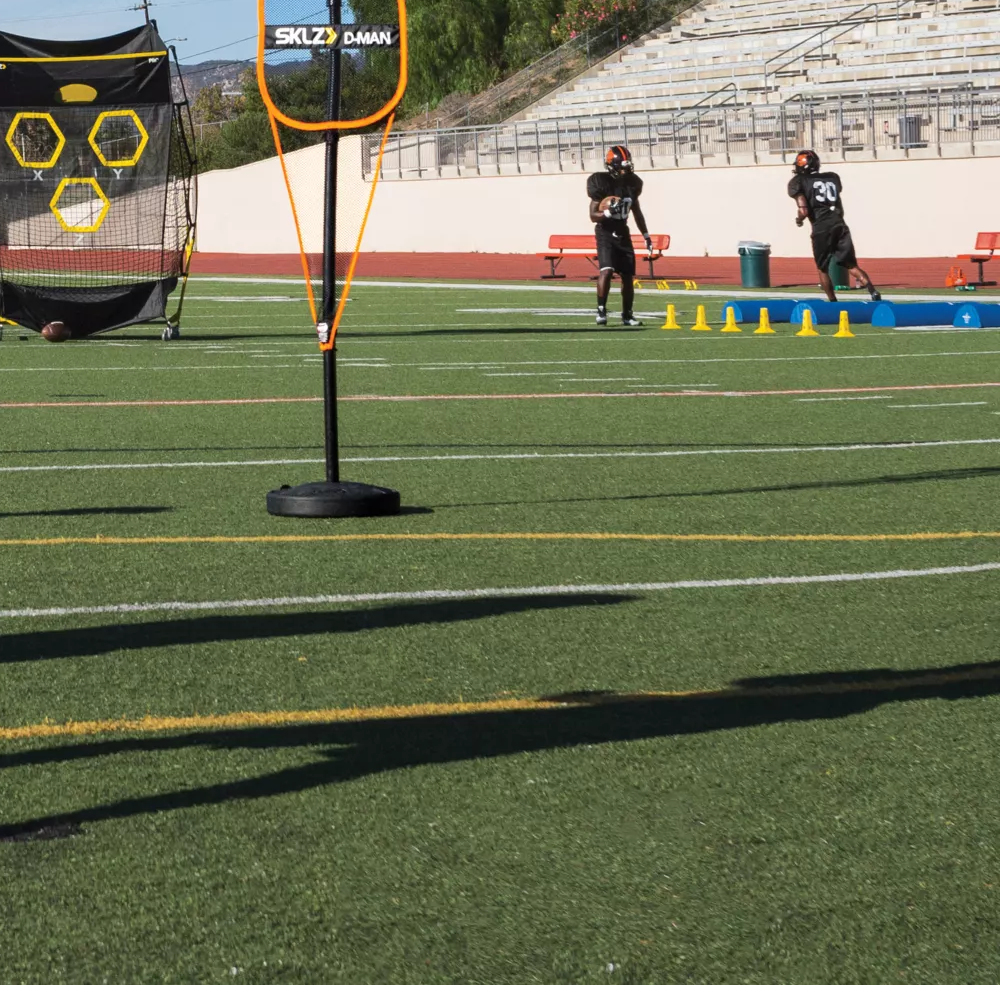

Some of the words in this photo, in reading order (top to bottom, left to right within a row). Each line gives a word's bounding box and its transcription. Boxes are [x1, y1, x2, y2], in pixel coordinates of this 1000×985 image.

[275, 27, 325, 45] SKLZ
[343, 31, 391, 45] D-MAN
[33, 170, 43, 181] X
[113, 168, 123, 180] Y
[813, 181, 837, 202] 30
